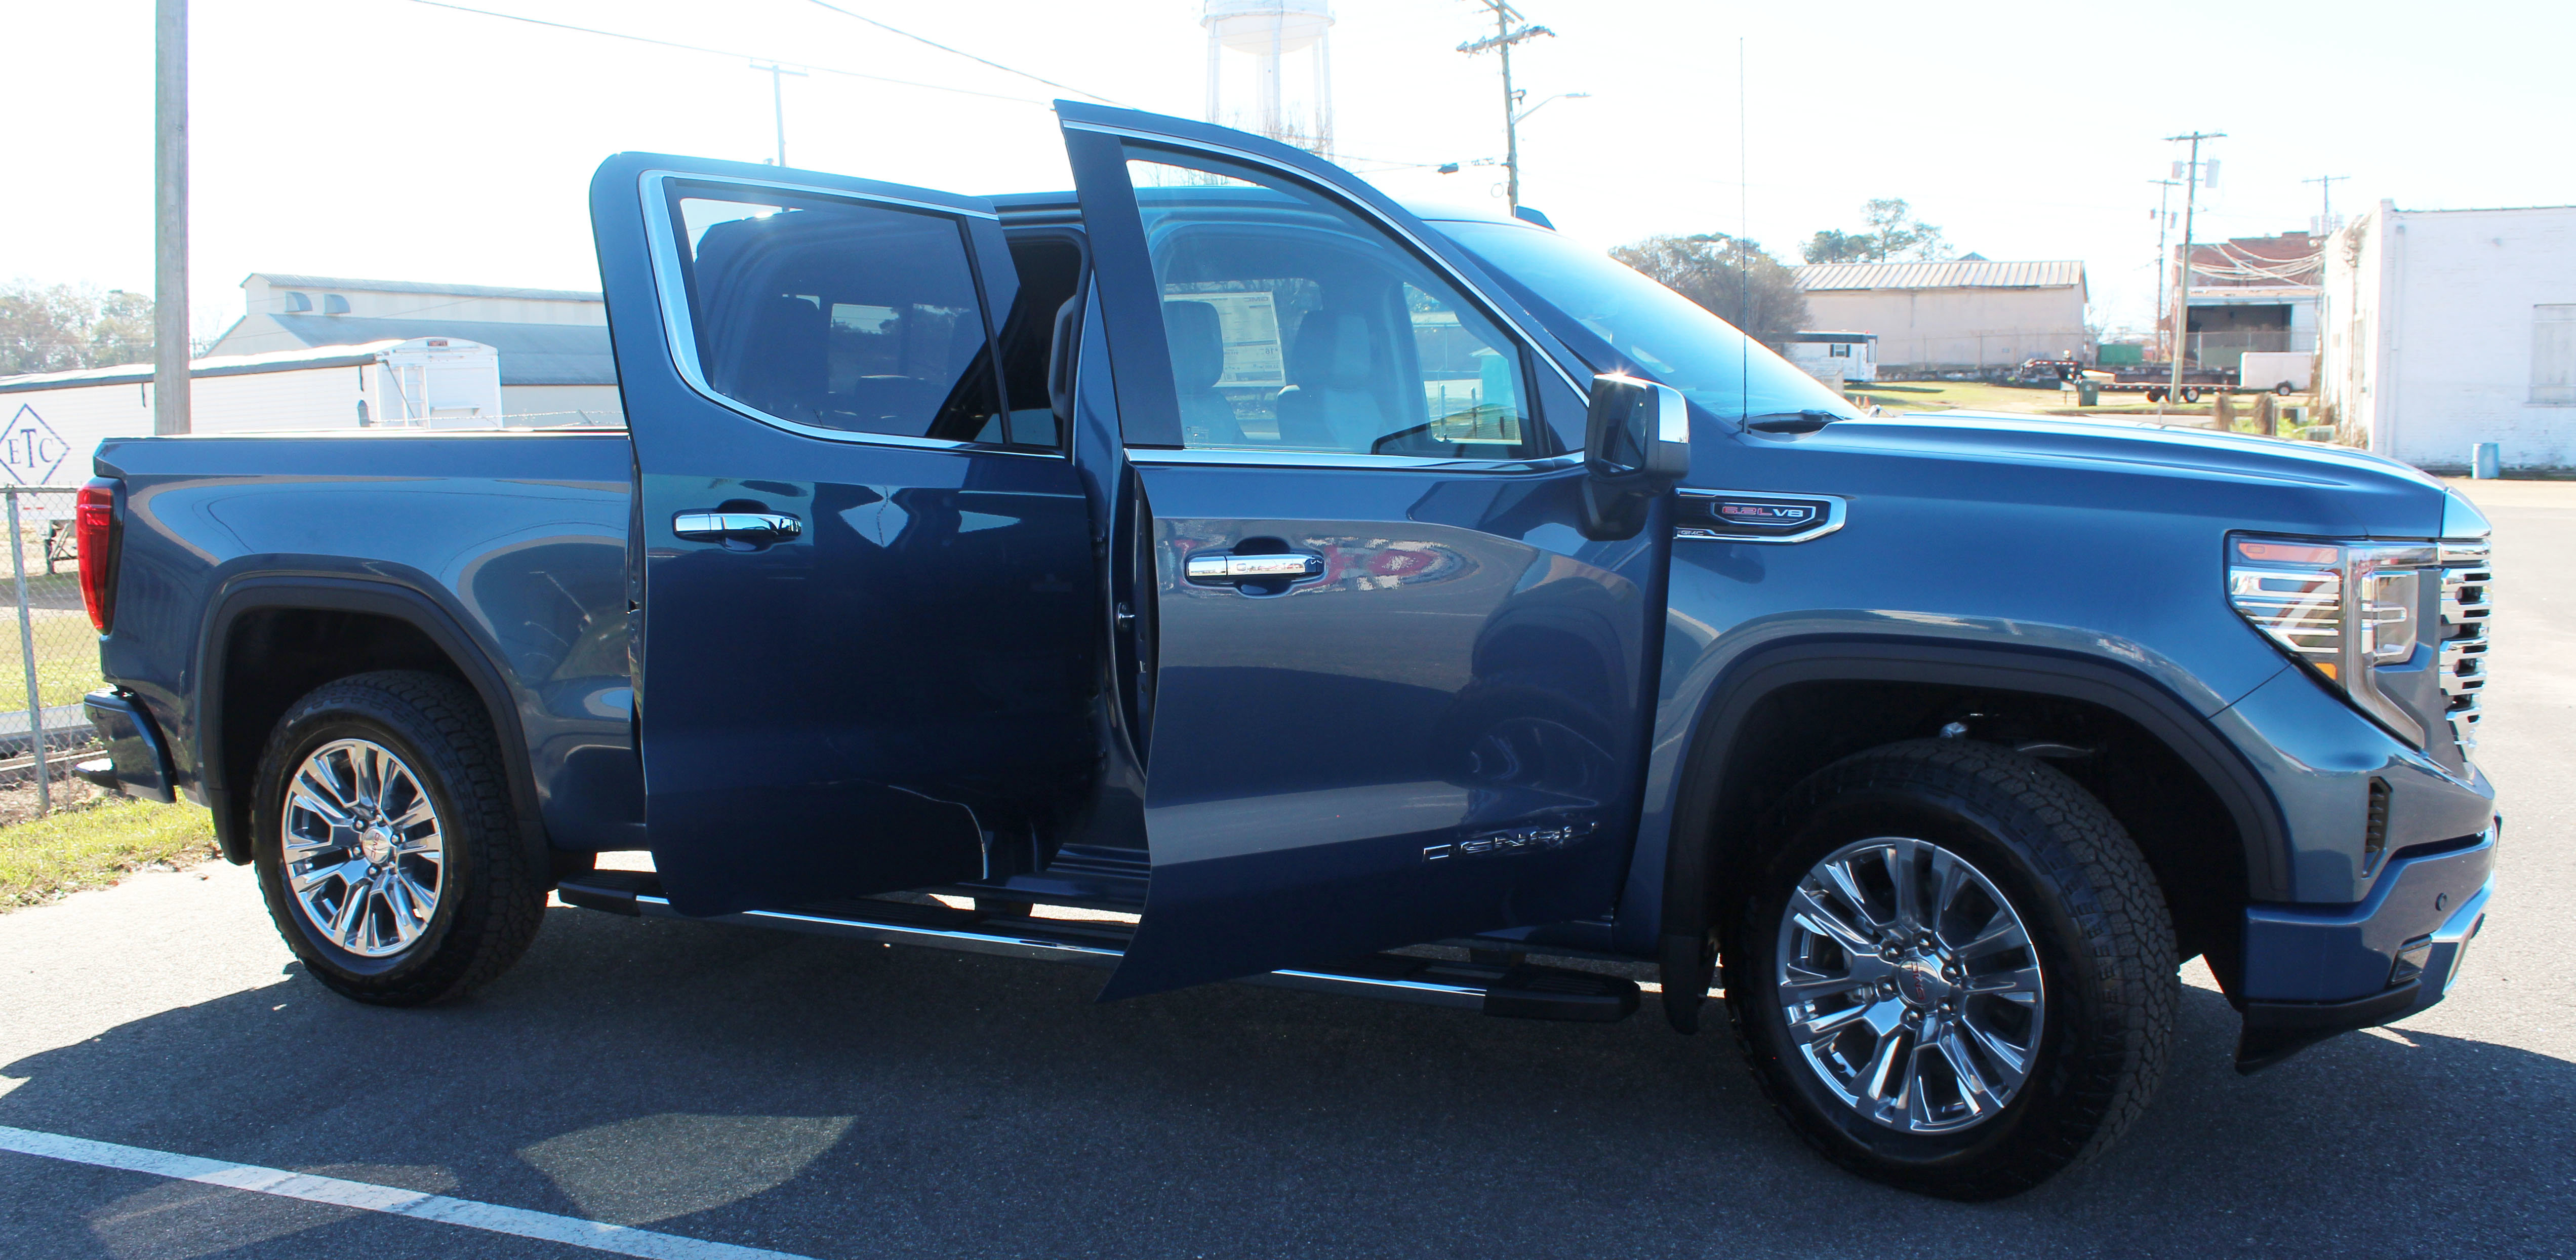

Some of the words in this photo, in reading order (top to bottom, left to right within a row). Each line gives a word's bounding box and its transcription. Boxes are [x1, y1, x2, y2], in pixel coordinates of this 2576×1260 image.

[7, 428, 54, 468] ETC
[371, 832, 380, 859] GMC
[1911, 961, 1925, 1000] GMC
